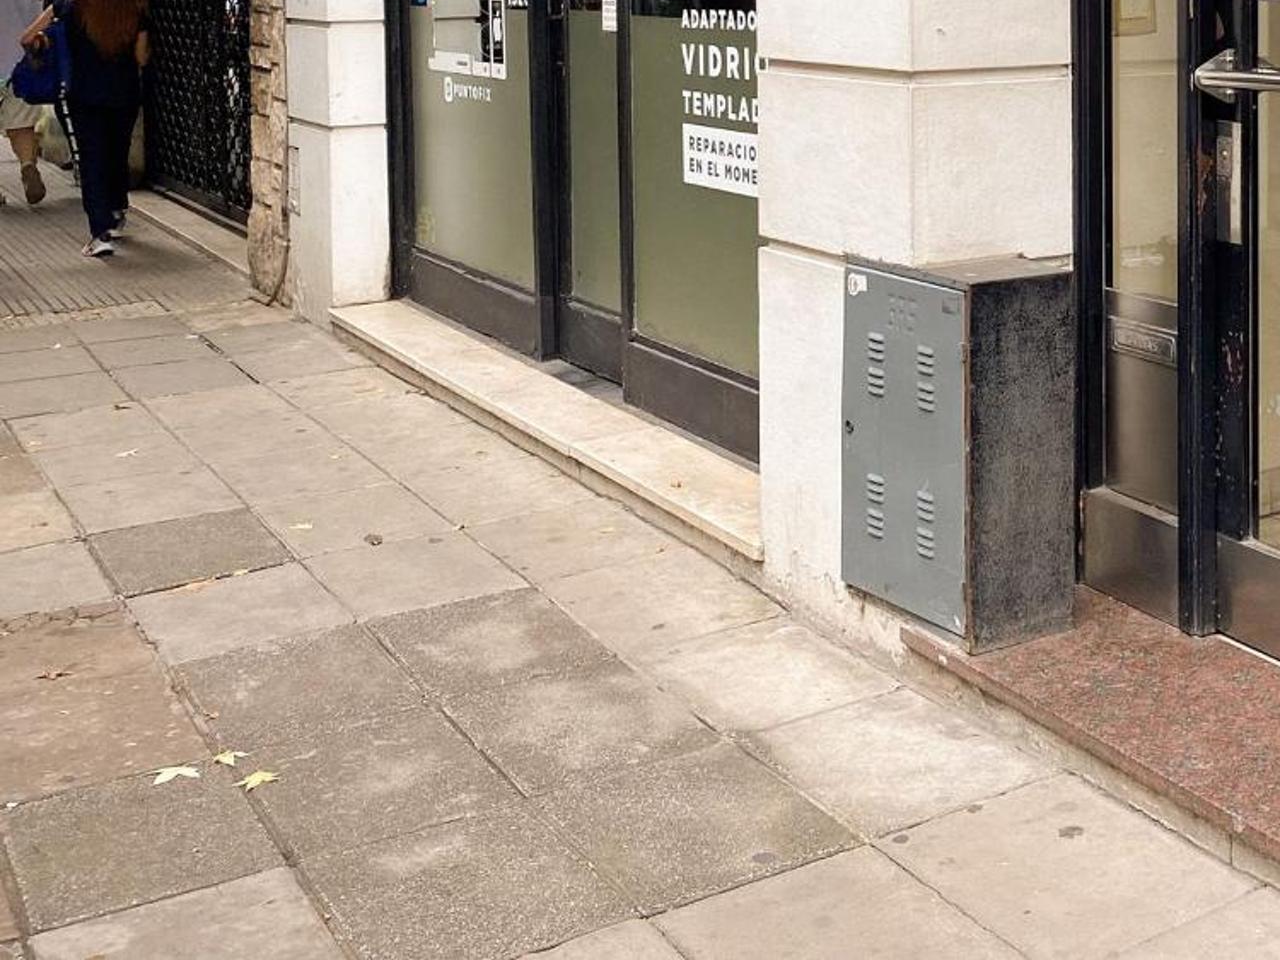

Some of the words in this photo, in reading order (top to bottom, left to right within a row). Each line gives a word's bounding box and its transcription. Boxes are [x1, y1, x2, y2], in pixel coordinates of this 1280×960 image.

[681, 8, 757, 32] ADAPTADO
[682, 89, 759, 124] TEMPLAD
[688, 136, 758, 162] REPARACIO
[689, 157, 703, 174] EN
[707, 160, 720, 178] EL
[724, 164, 758, 185] MOME
